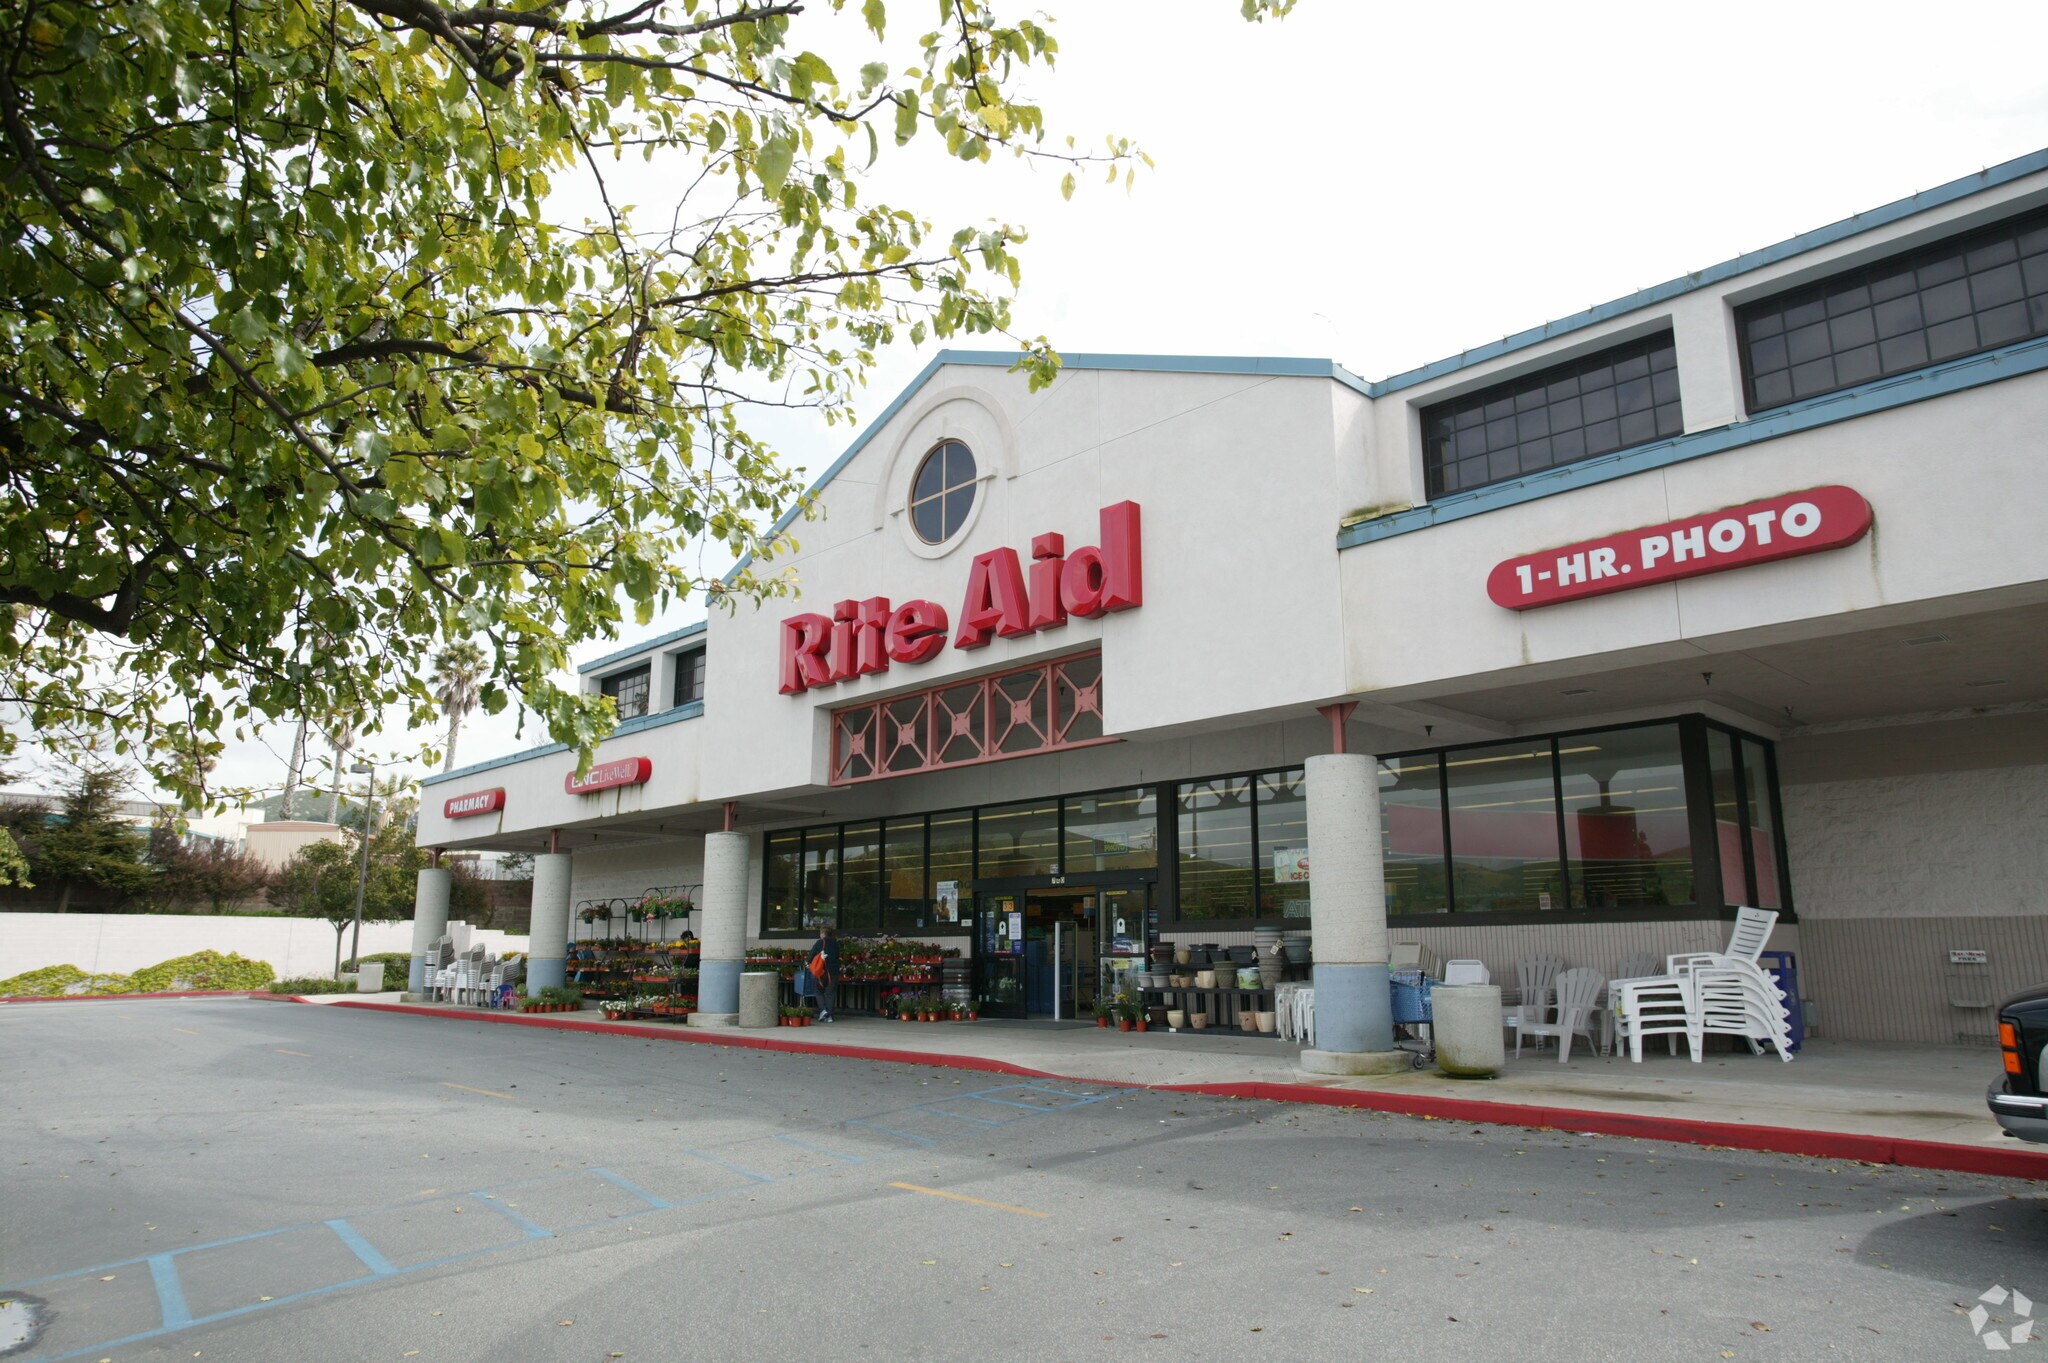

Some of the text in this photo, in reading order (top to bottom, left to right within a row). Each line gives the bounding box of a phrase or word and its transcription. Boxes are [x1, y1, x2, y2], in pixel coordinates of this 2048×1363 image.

[1516, 502, 1822, 595] 1-HR. PHOTO
[779, 500, 1143, 696] Rite Aid
[449, 794, 489, 815] PHARMACY
